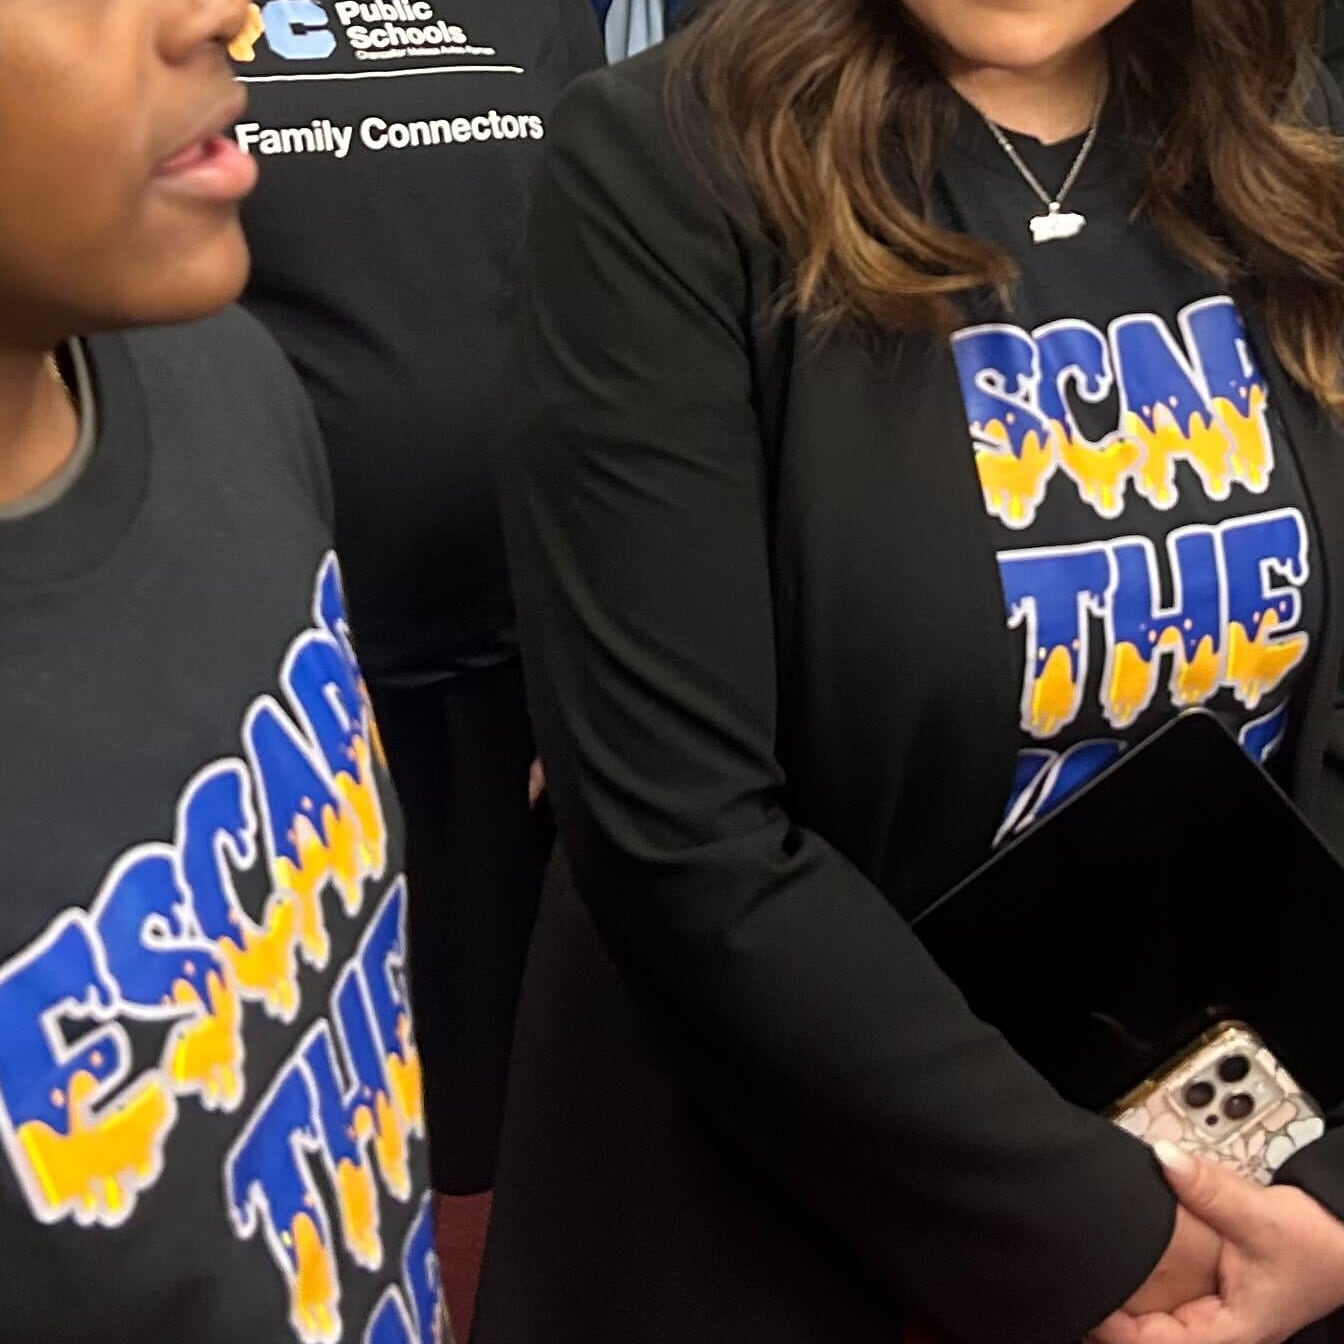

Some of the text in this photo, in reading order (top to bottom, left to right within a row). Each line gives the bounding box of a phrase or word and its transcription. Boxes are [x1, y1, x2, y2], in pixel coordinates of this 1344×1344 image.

[346, 20, 467, 49] Schools
[234, 109, 544, 159] Family Connectors
[995, 507, 1310, 739] THE
